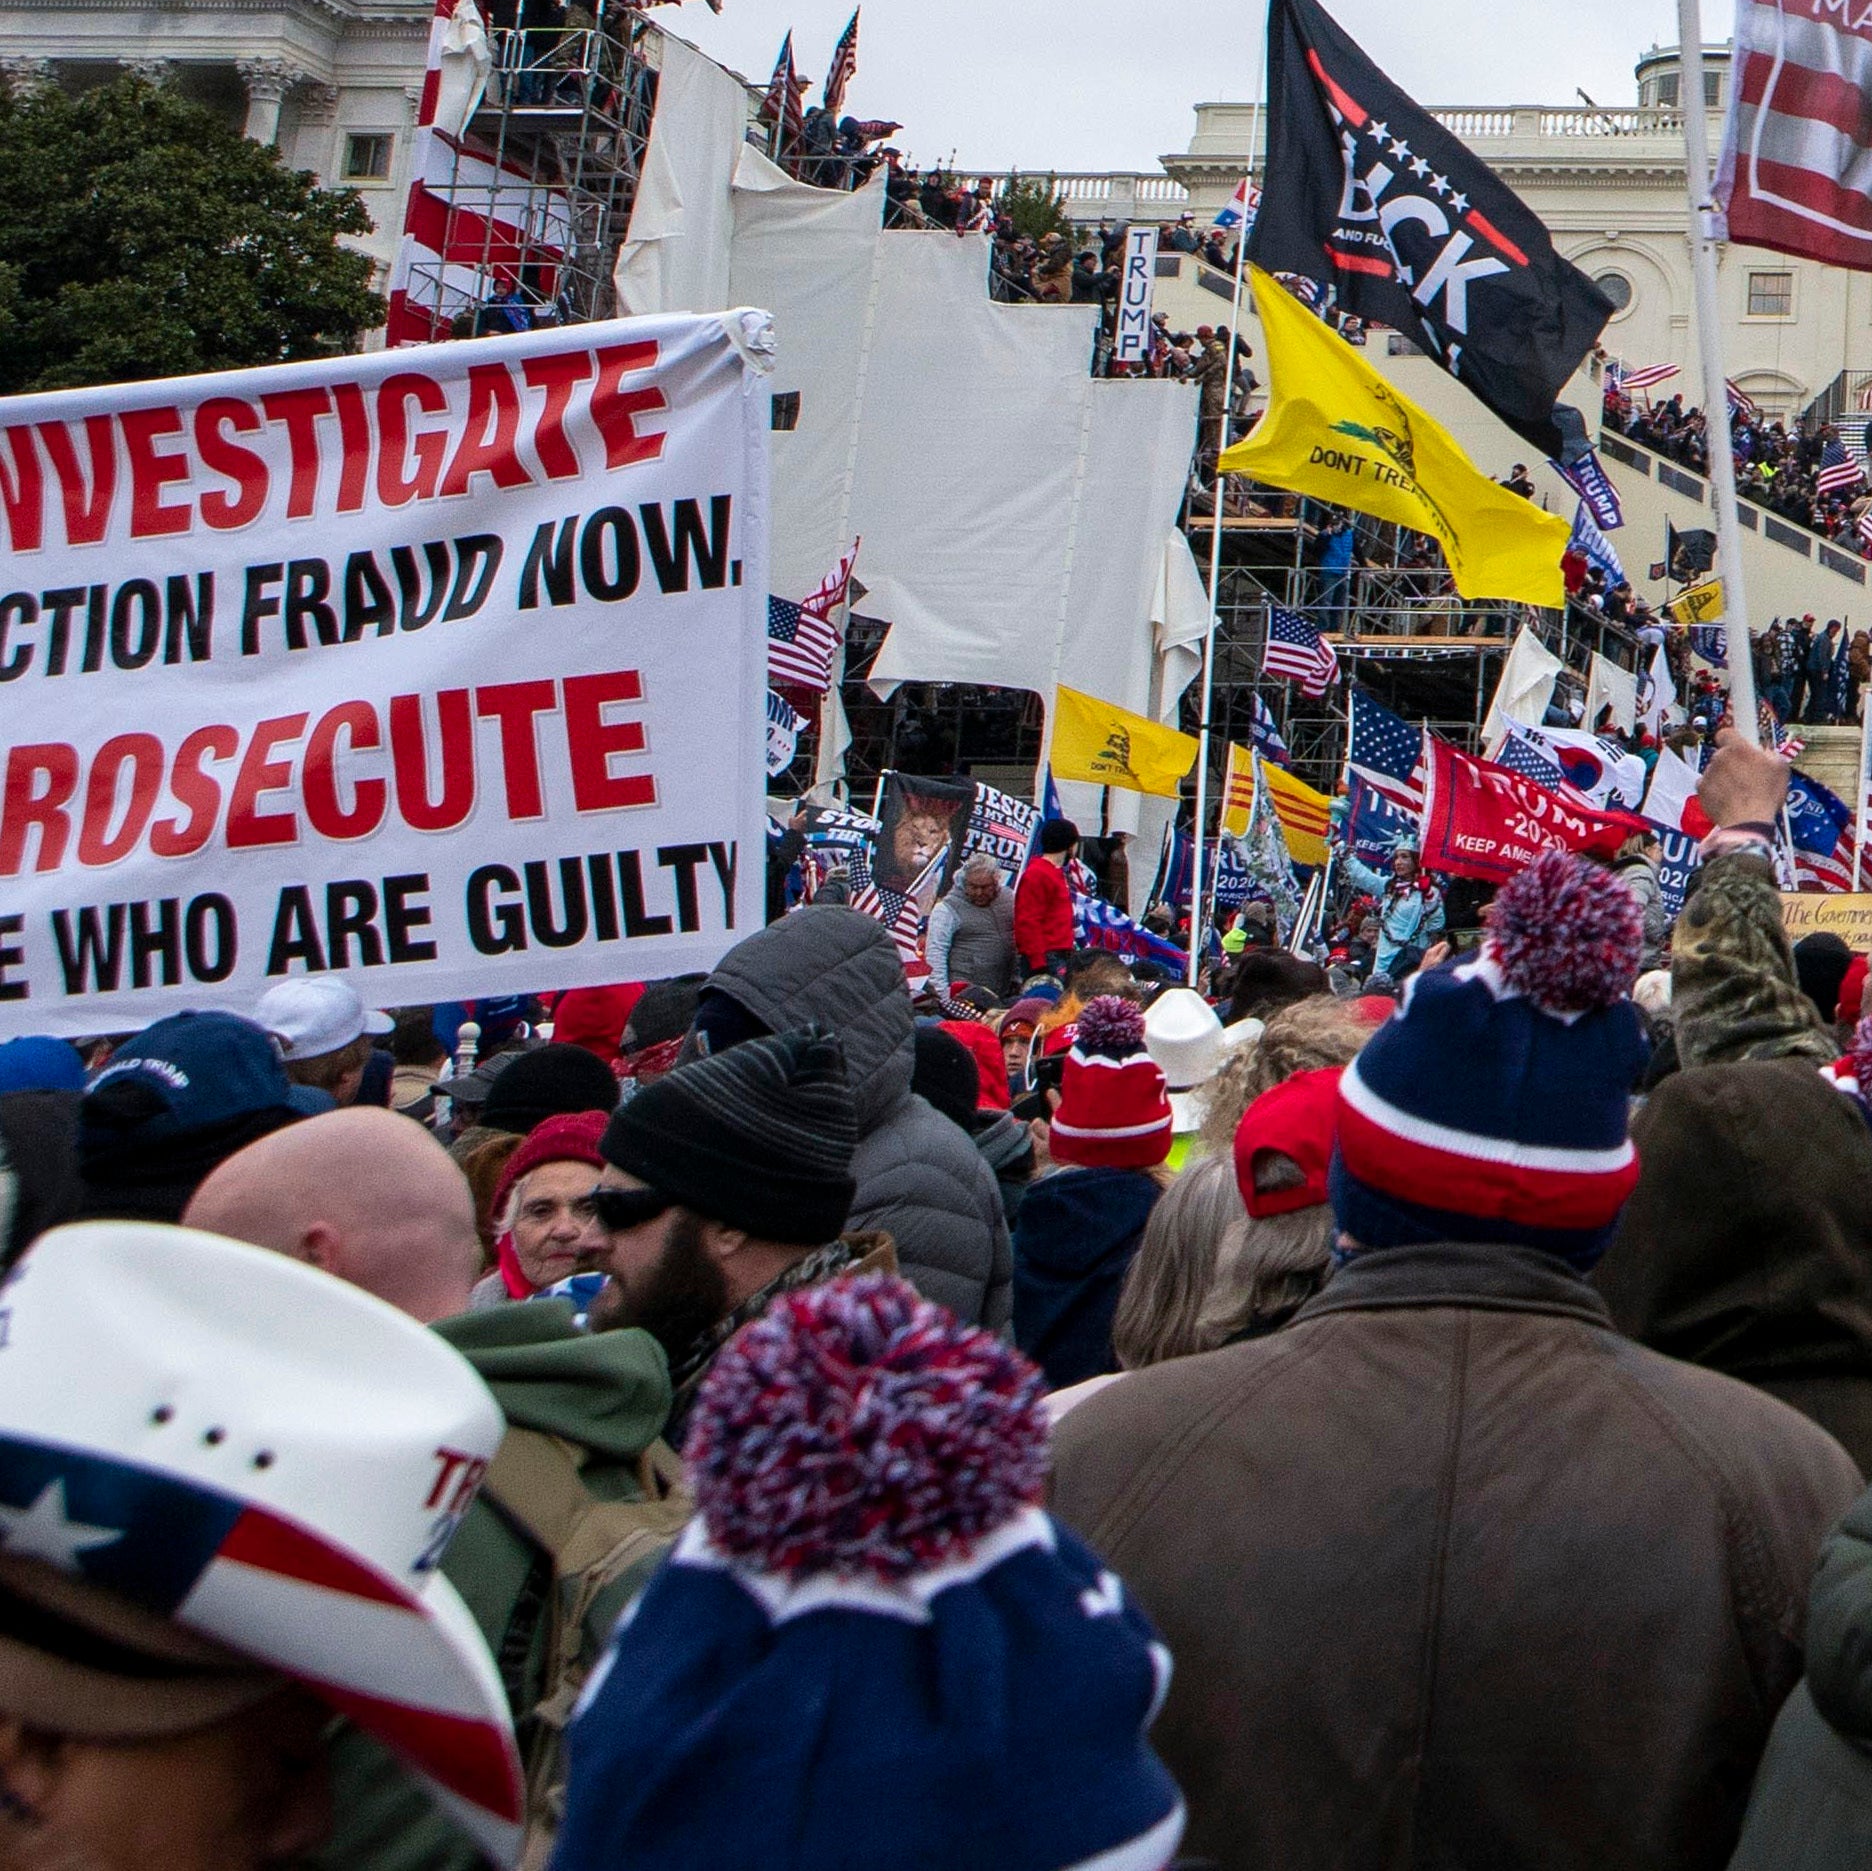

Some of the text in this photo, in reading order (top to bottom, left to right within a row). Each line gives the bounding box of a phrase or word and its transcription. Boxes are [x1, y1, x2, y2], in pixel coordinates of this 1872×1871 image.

[1332, 228, 1364, 243] AND
[1121, 232, 1150, 359] TRUMP
[0, 340, 668, 554] NVESTIGATE
[1309, 445, 1367, 476] DONT
[1576, 452, 1618, 527] TRUMP
[0, 494, 743, 681] CTION FRAUD NOW.
[0, 669, 657, 876] ROSECUTE
[1454, 752, 1613, 837] TRUM
[1787, 789, 1825, 818] 2ND
[816, 809, 884, 831] STOP
[986, 808, 1006, 826] MY
[1454, 833, 1498, 853] KEEP
[1217, 874, 1256, 890] 2020
[52, 895, 236, 996] WHO
[266, 874, 438, 976] ARE
[466, 840, 738, 956] GUILTY
[1783, 899, 1812, 926] The
